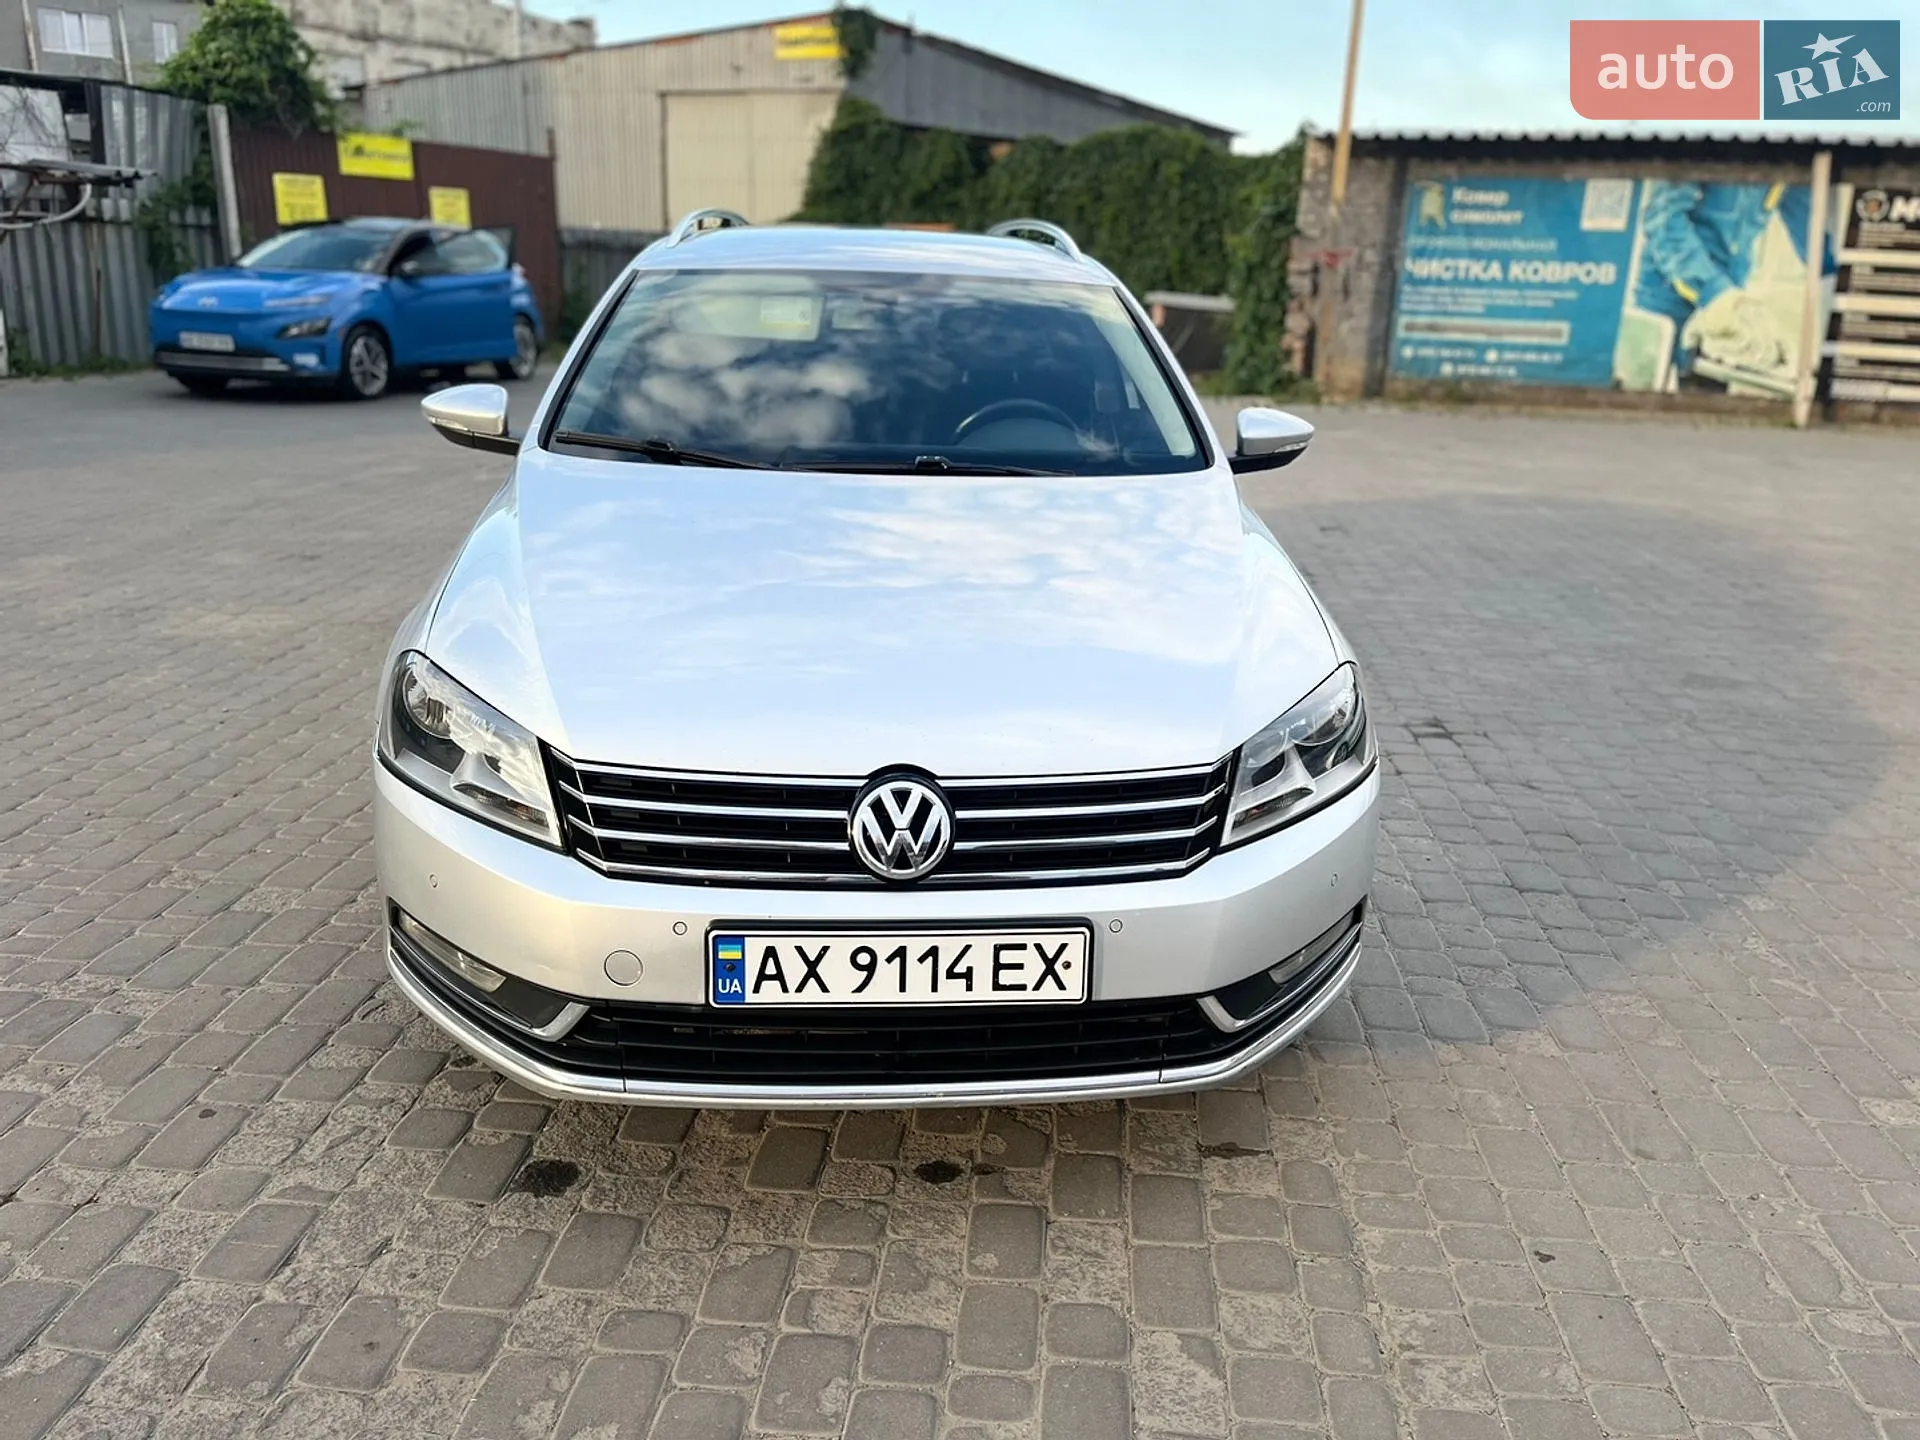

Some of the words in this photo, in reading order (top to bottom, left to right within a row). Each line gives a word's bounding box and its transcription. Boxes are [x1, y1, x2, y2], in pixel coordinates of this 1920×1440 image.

[1403, 255, 1503, 282] ЧИСТКА
[1508, 259, 1617, 286] КОВРОВ
[752, 945, 831, 994] AX
[849, 944, 974, 994] 9114
[992, 942, 1069, 992] EX
[718, 978, 743, 994] UA
